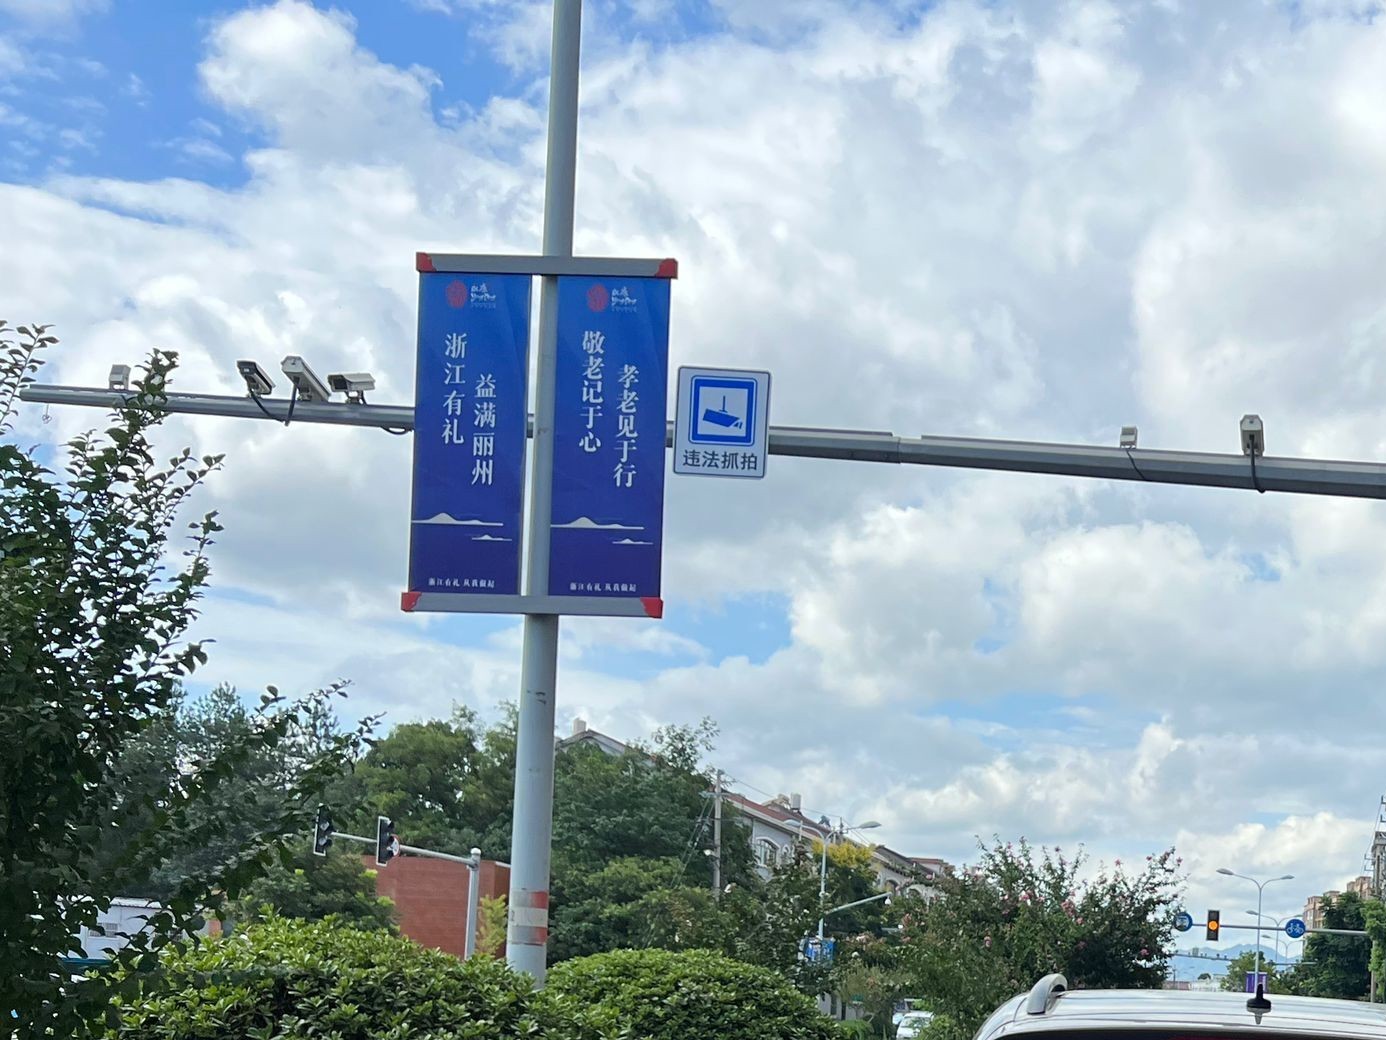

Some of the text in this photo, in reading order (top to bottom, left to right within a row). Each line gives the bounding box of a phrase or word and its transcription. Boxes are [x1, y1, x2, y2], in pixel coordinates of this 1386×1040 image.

[442, 333, 467, 446] 浙江有礼
[471, 374, 496, 486] 益满丽州
[578, 330, 606, 453] 敬老记于心
[613, 364, 640, 489] 孝老见于行
[682, 449, 758, 472] 违法抓拍
